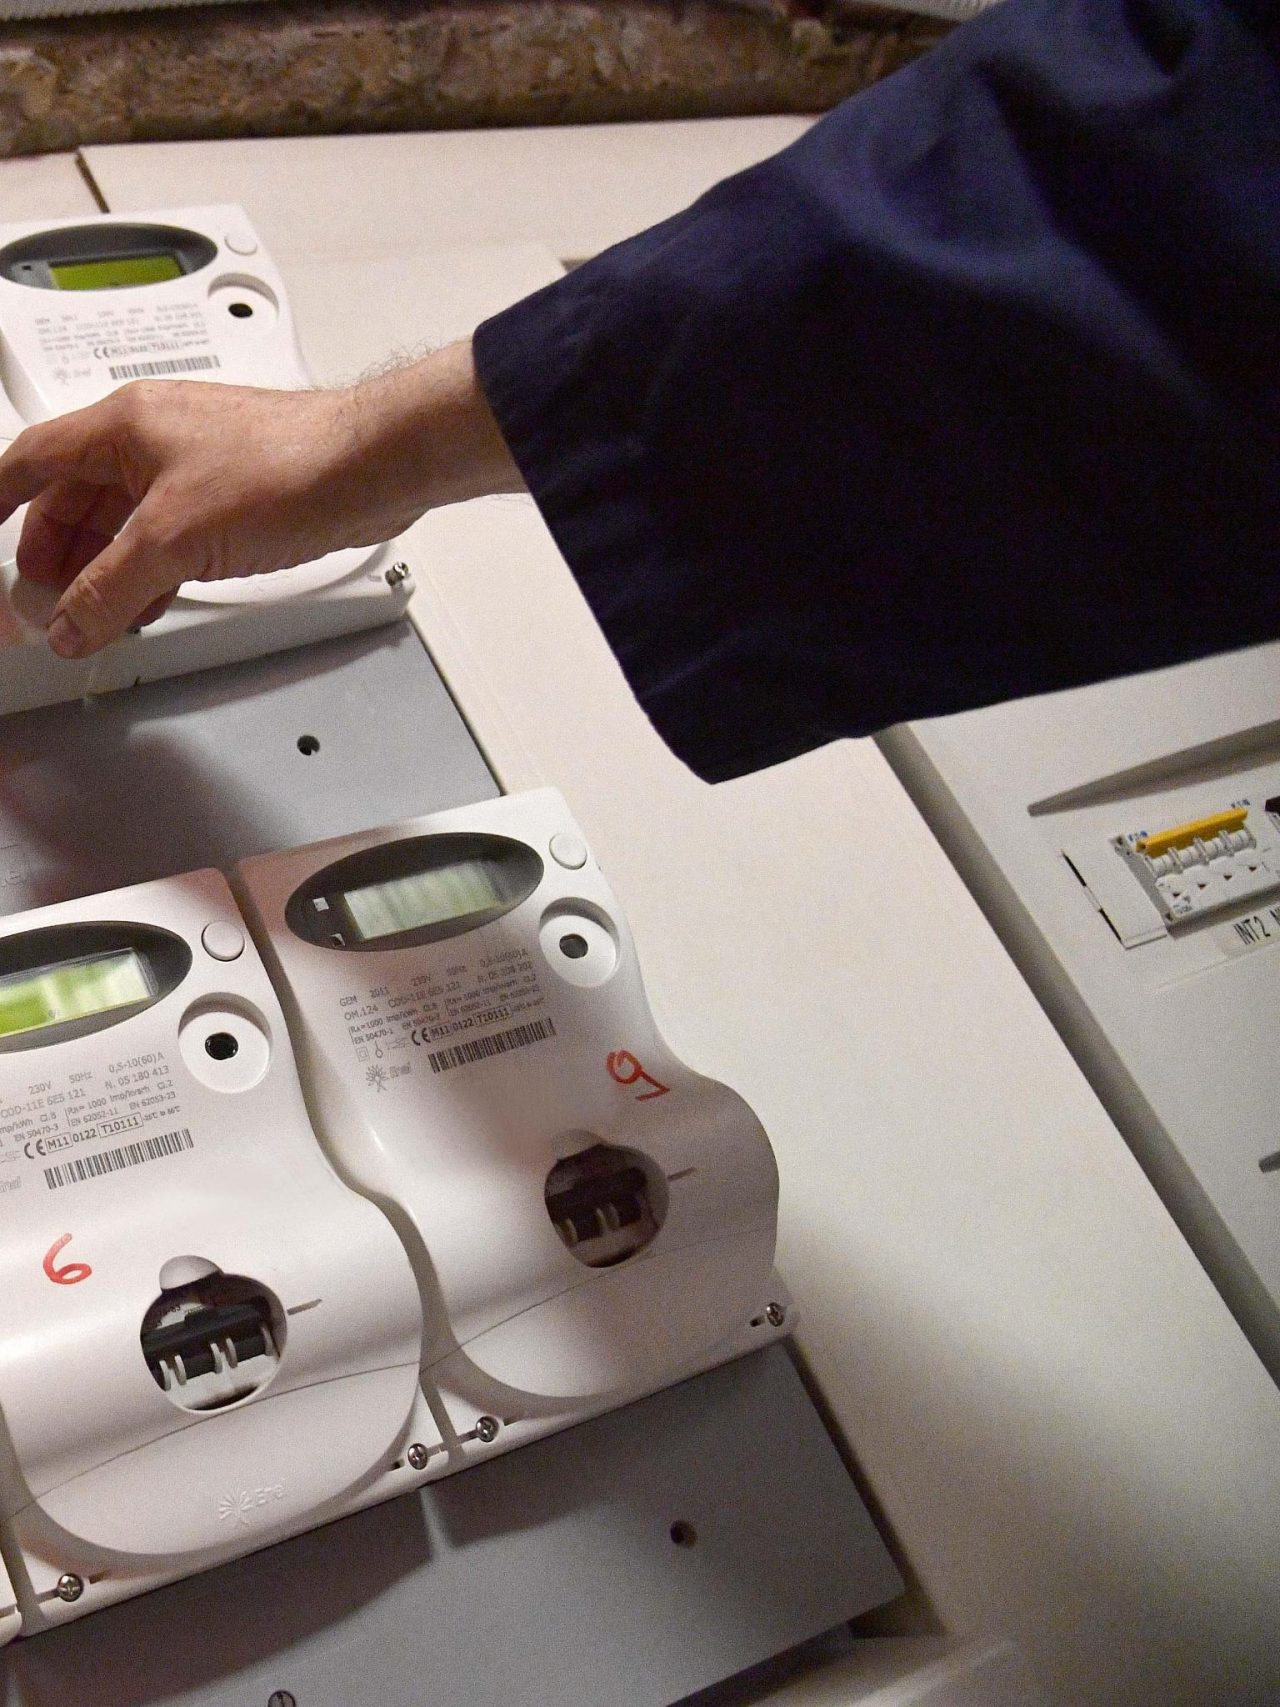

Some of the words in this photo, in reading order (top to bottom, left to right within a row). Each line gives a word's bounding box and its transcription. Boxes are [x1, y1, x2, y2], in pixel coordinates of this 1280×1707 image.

[28, 1080, 52, 1095] 230V
[607, 1050, 670, 1101] 9
[47, 1136, 70, 1150] M11
[72, 1128, 97, 1143] 0122
[100, 1116, 139, 1134] T10111
[43, 1233, 92, 1284] 6
